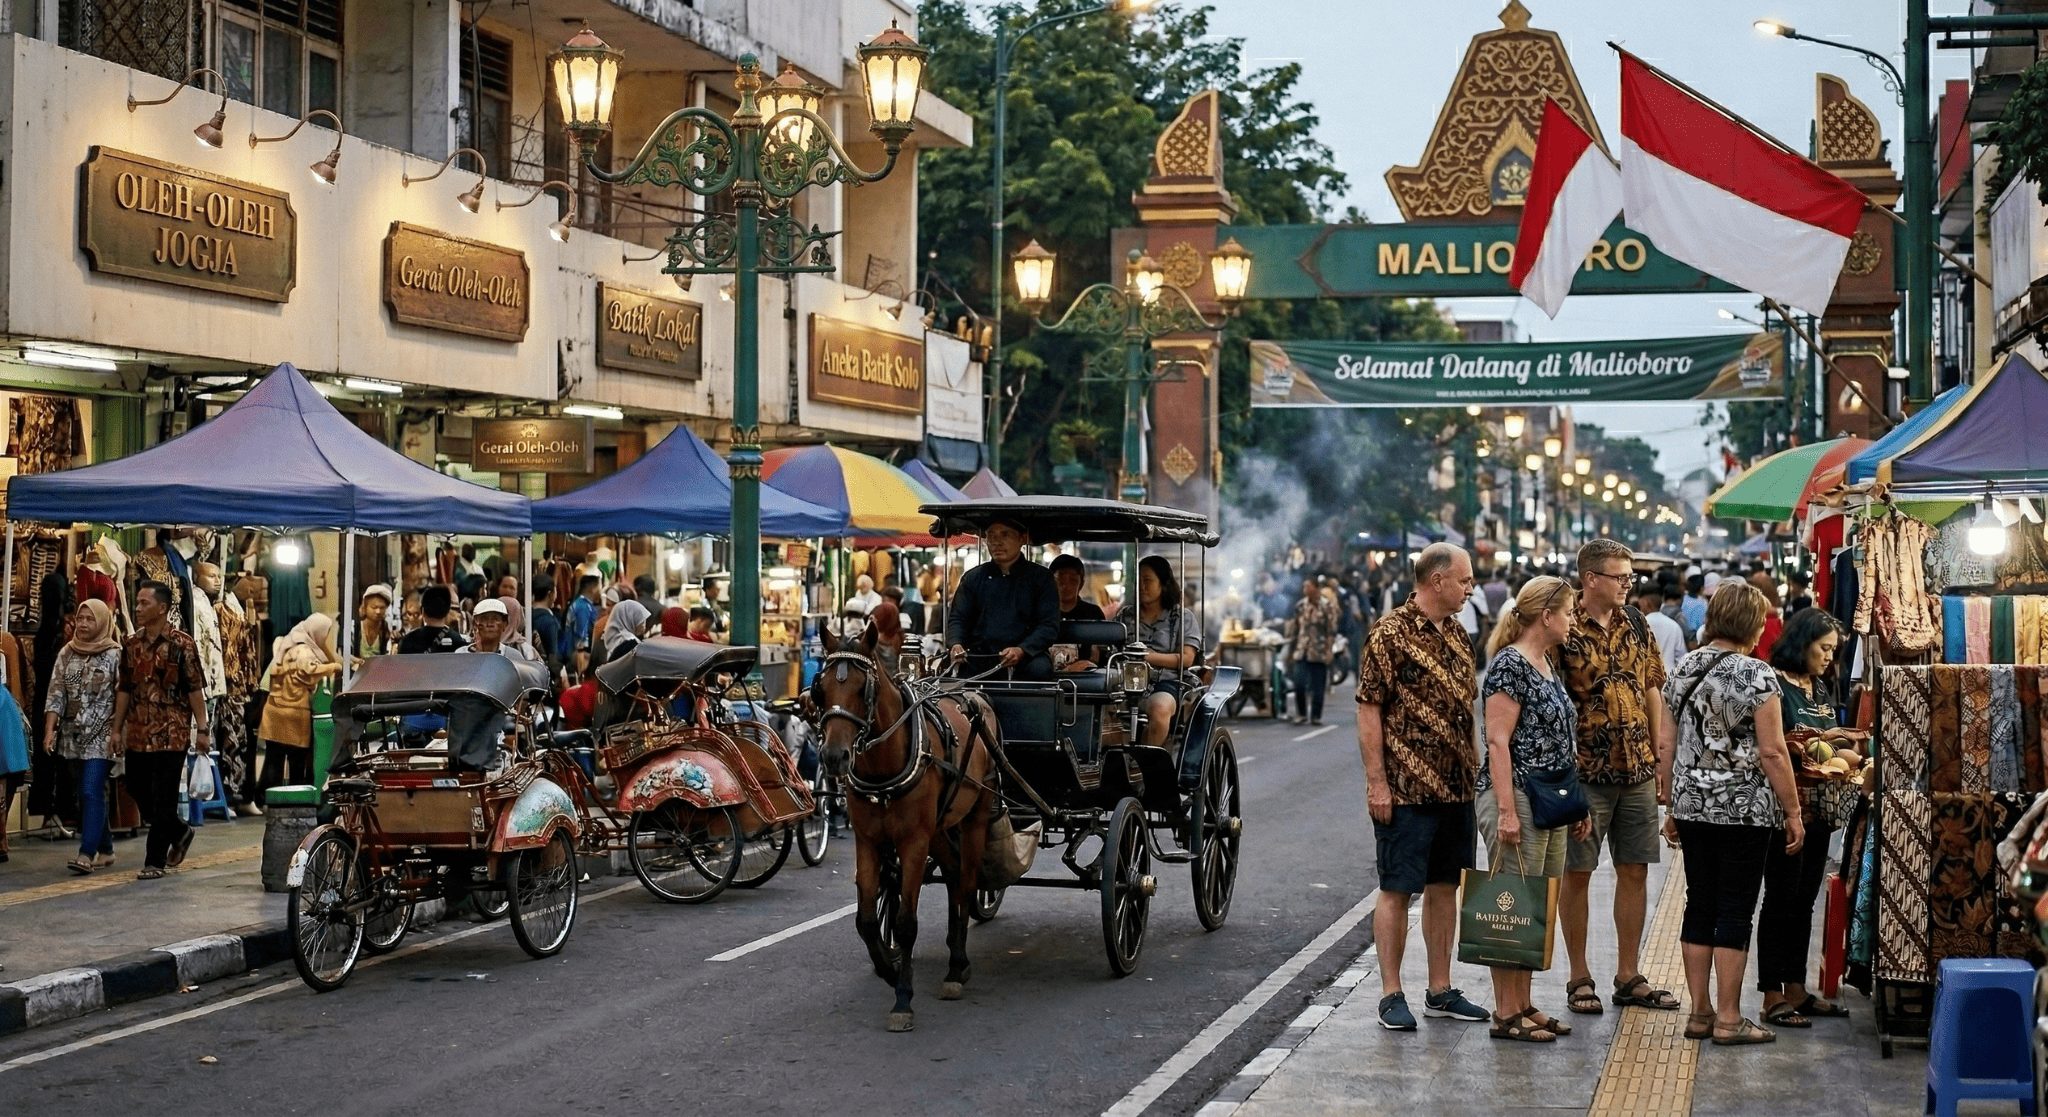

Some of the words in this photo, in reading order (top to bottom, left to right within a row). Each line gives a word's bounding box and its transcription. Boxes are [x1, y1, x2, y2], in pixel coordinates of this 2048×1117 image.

[117, 172, 276, 240] OLEH-OLEH
[156, 227, 239, 276] JOGJA
[1378, 238, 1647, 275] MALIORO
[401, 255, 444, 292] Gerai
[448, 265, 521, 307] Oleh-Oleh
[610, 300, 655, 345] Batik
[655, 309, 699, 351] Lokal
[821, 340, 860, 380] Aneka
[861, 348, 893, 386] Batik
[894, 356, 919, 390] Solo
[1334, 353, 1435, 380] Selamat
[1440, 353, 1531, 385] Datang
[1536, 353, 1562, 378] di
[1568, 351, 1694, 377] Malioboro
[480, 441, 513, 454] Gerai
[516, 440, 579, 454] Oleh-Oleh
